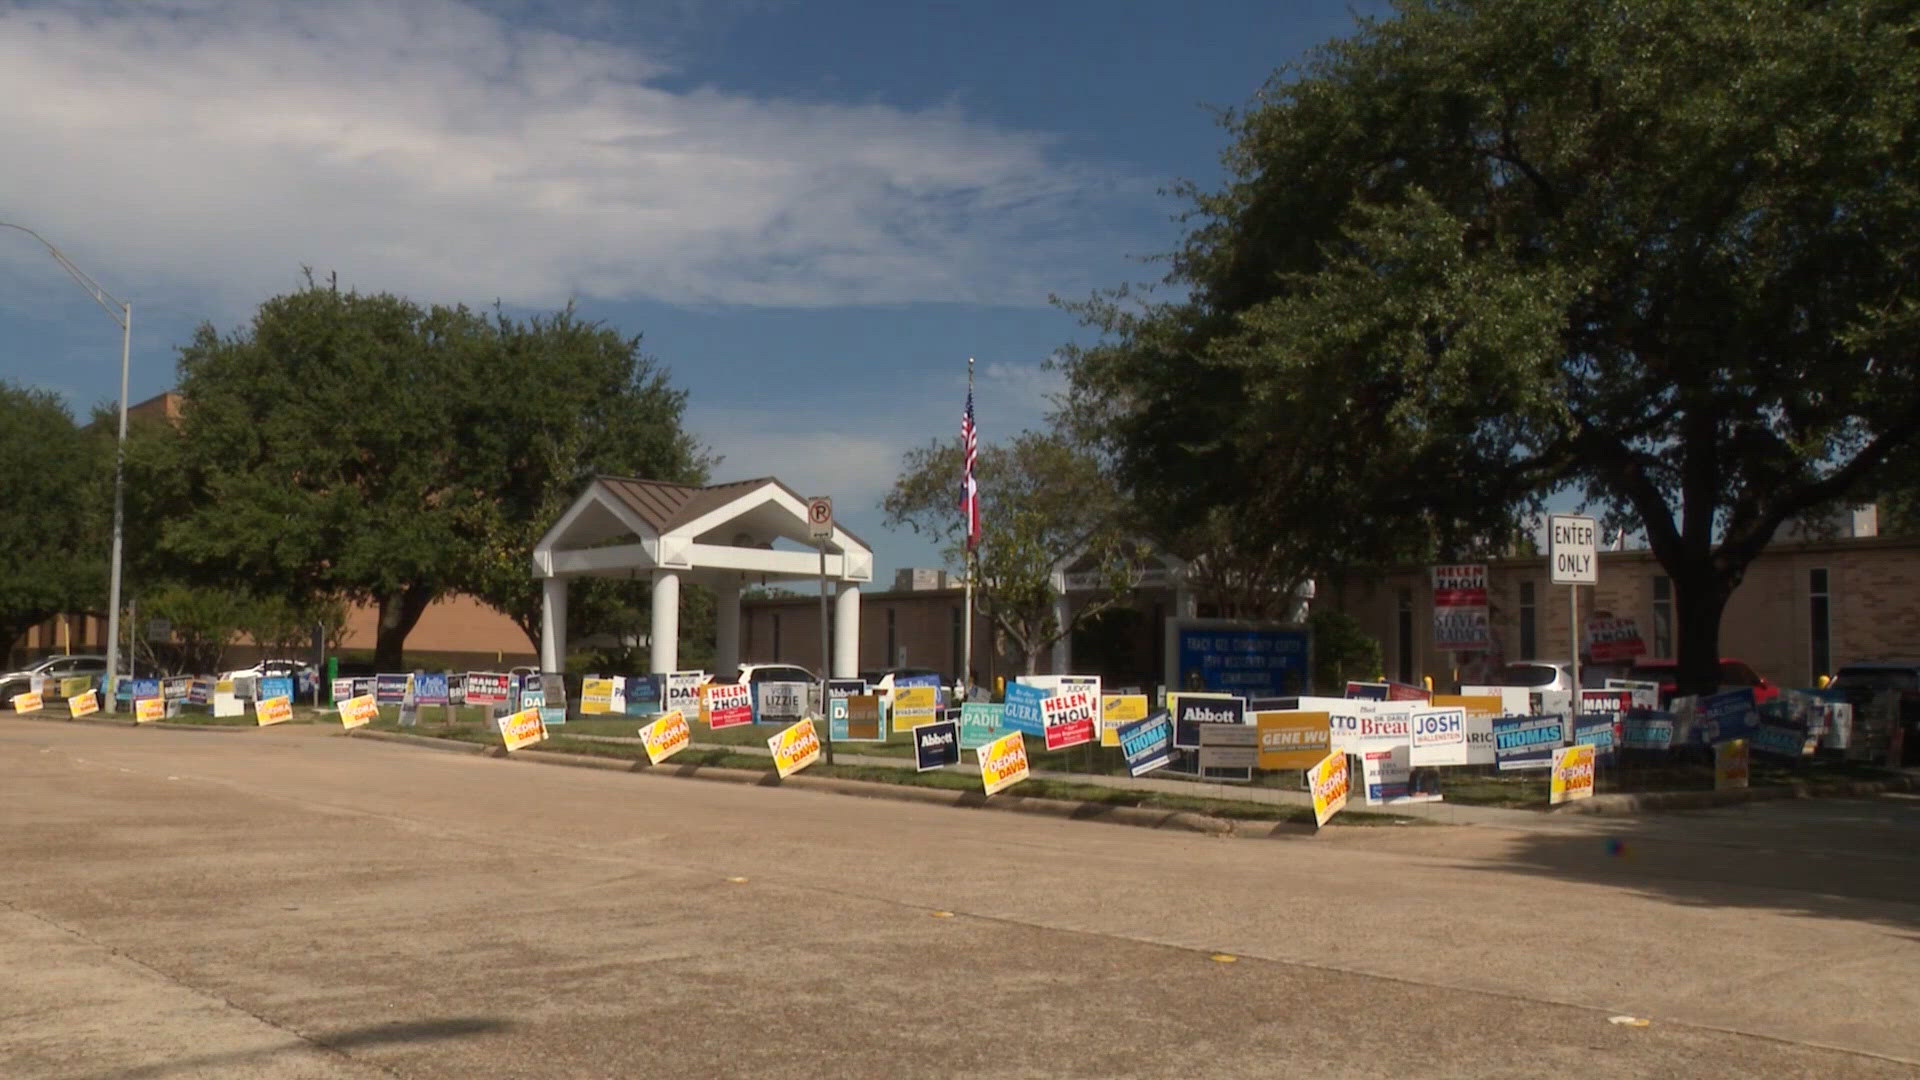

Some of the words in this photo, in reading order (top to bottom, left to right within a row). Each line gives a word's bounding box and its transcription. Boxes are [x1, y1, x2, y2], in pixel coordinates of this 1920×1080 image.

[1555, 526, 1593, 546] ENTER
[1558, 554, 1591, 573] ONLY
[670, 687, 700, 698] DAN
[712, 687, 747, 700] HELEN
[766, 696, 800, 706] LIZZIE
[713, 697, 749, 711] ZHOU
[1045, 693, 1087, 712] HELEN
[1583, 698, 1620, 711] MANO
[1048, 706, 1089, 727] ZHOU
[1183, 707, 1234, 723] Abbott
[1416, 715, 1460, 735] JOSH
[780, 733, 818, 759] DEDRA
[921, 731, 953, 748] Abbott
[1262, 732, 1301, 746] GENE
[1303, 731, 1328, 742] WU
[1497, 726, 1560, 749] THOMAS
[792, 741, 818, 763] DAVIS
[988, 750, 1026, 774] DEDRA
[998, 761, 1027, 780] DAVIS
[1559, 764, 1592, 781] DEDRA
[1565, 775, 1592, 791] DAVIS
